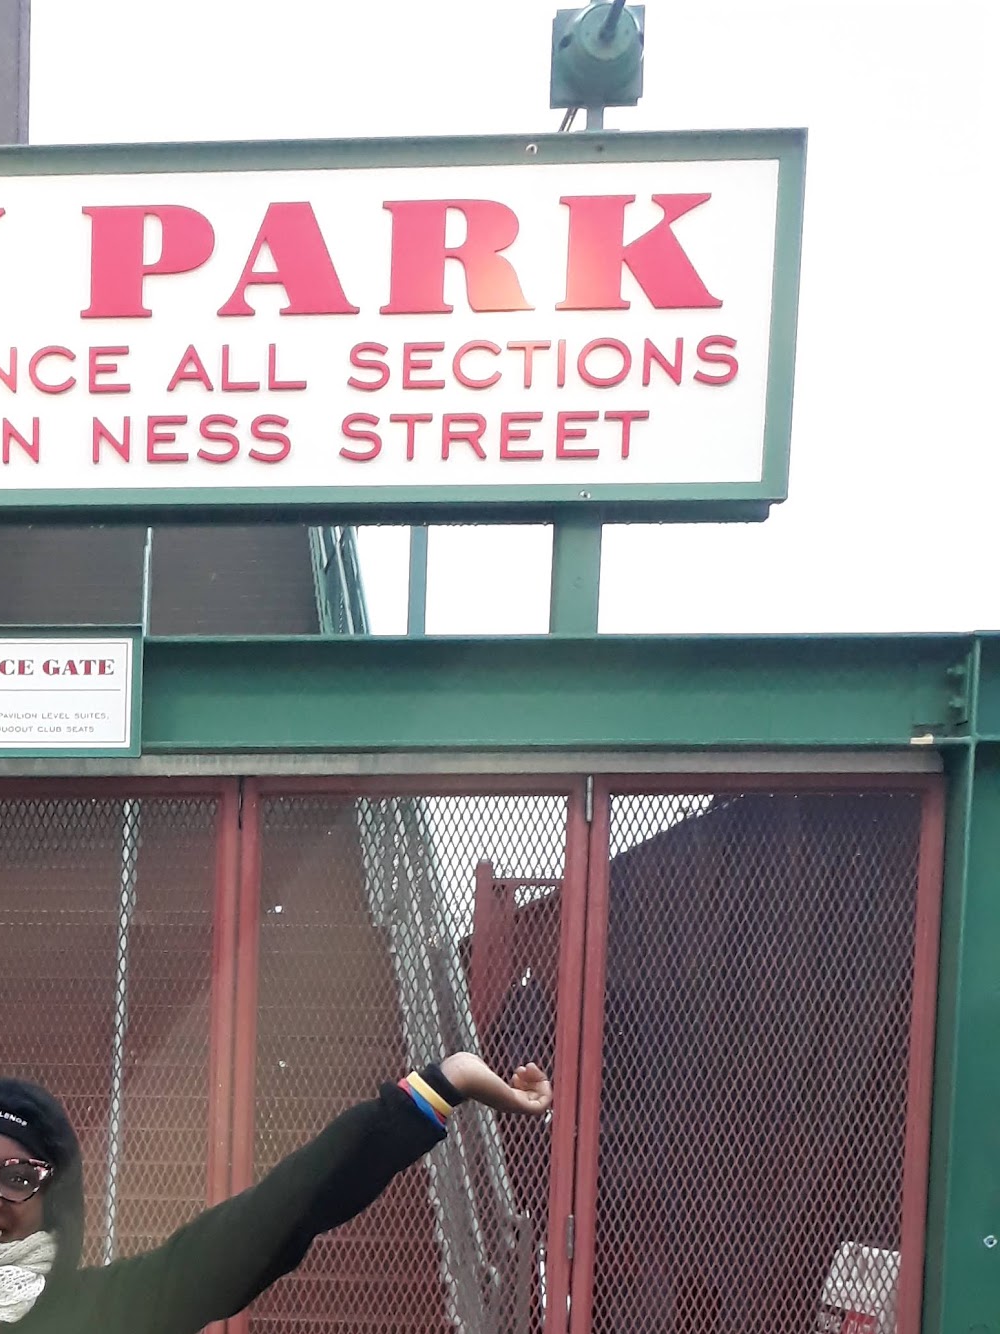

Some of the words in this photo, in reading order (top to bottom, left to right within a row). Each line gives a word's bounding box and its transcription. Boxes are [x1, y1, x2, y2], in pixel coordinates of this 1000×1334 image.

[81, 194, 721, 319] PARK
[168, 345, 306, 391] ALL
[347, 335, 738, 391] SECTIONS
[93, 414, 290, 463] NESS
[340, 411, 648, 461] STREET
[42, 659, 115, 676] GATE
[41, 712, 70, 720] LEVEL
